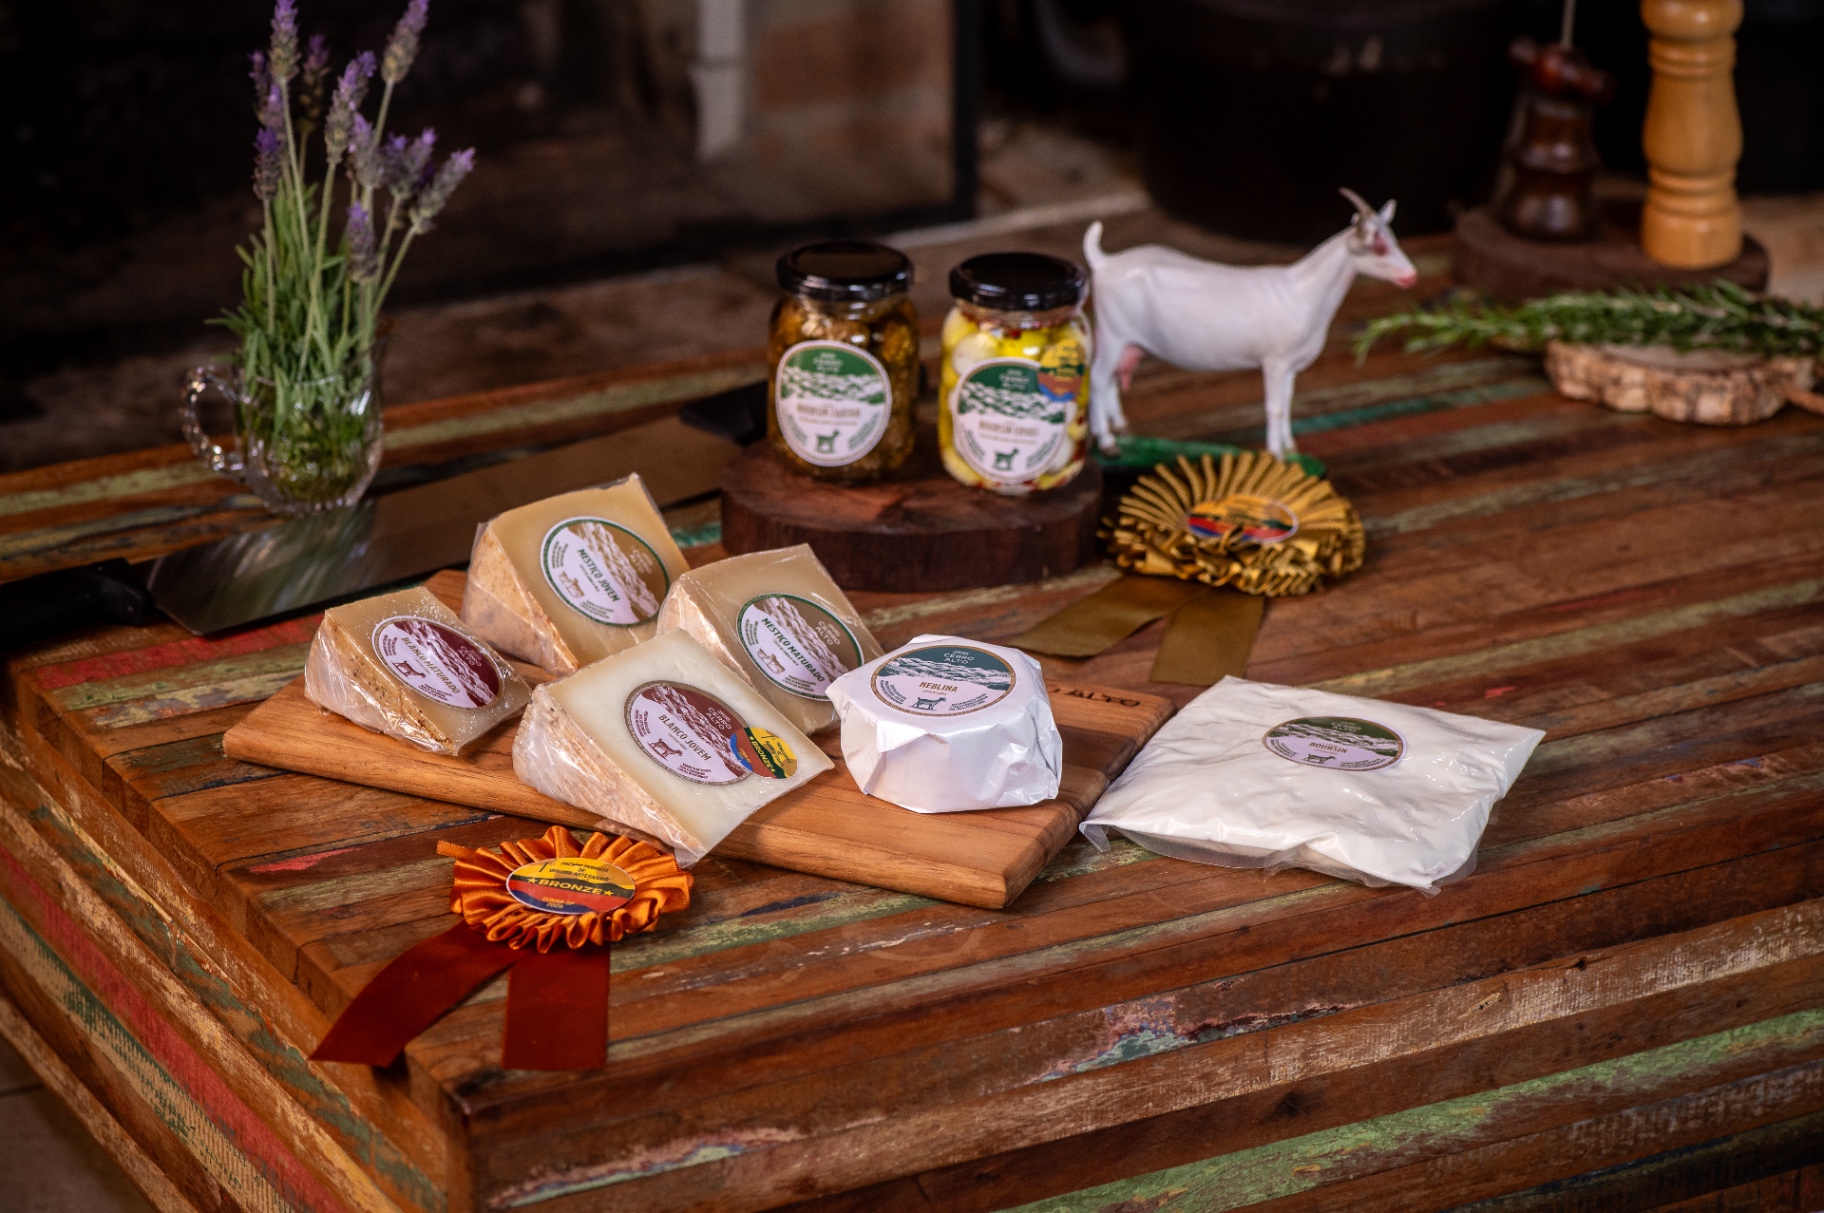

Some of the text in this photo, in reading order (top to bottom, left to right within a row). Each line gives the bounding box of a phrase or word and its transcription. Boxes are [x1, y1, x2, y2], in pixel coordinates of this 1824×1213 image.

[577, 549, 603, 578] MESTIÇO
[598, 576, 620, 602] JOVEM
[815, 627, 833, 645] ALTO
[818, 621, 840, 645] CERRO
[457, 649, 474, 666] ALTO
[761, 617, 791, 649] MESTIÇO
[788, 645, 826, 682] MATURADO
[943, 653, 974, 661] CERRO
[401, 637, 427, 660] BLANCO
[424, 657, 461, 694] MATURADO
[919, 681, 958, 692] NEBLINA
[1065, 689, 1140, 707] ALTO
[705, 713, 725, 730] ALTO
[708, 707, 732, 730] CERRO
[658, 714, 687, 741] BLANCO
[684, 739, 712, 761] JOVEM
[751, 741, 773, 769] BRONZE
[1309, 742, 1348, 753] BOURSIN
[538, 880, 602, 895] BRONZE
